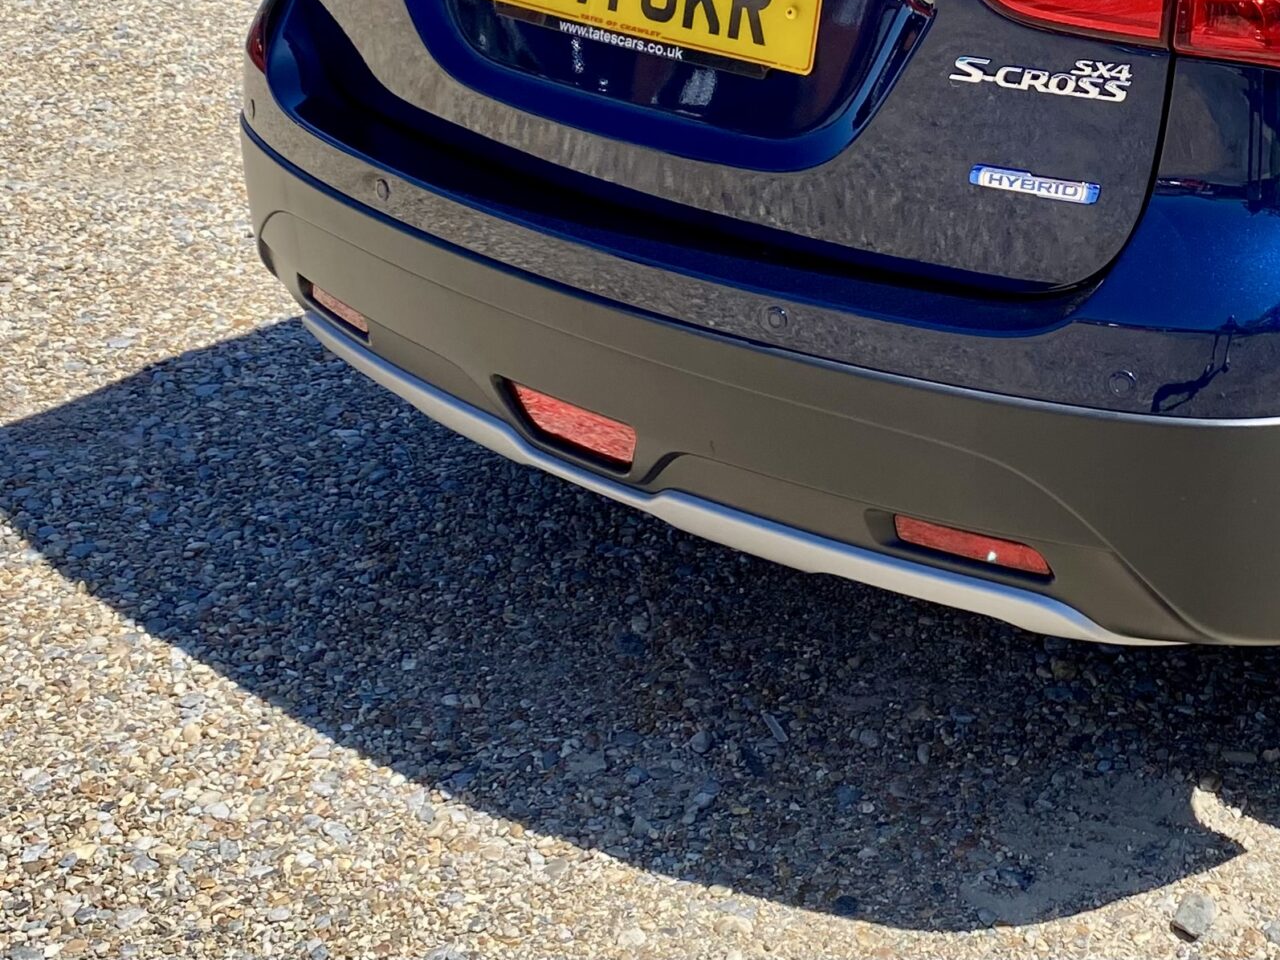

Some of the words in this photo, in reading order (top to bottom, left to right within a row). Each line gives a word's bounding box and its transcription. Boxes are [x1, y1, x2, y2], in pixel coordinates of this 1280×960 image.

[580, 14, 603, 24] TATES
[620, 23, 662, 38] CRAWLEY
[560, 20, 683, 60] www.tatescars.co.uk
[949, 56, 1132, 102] S-CROSS
[1070, 59, 1133, 82] SX4
[988, 173, 1079, 198] HYBRID
